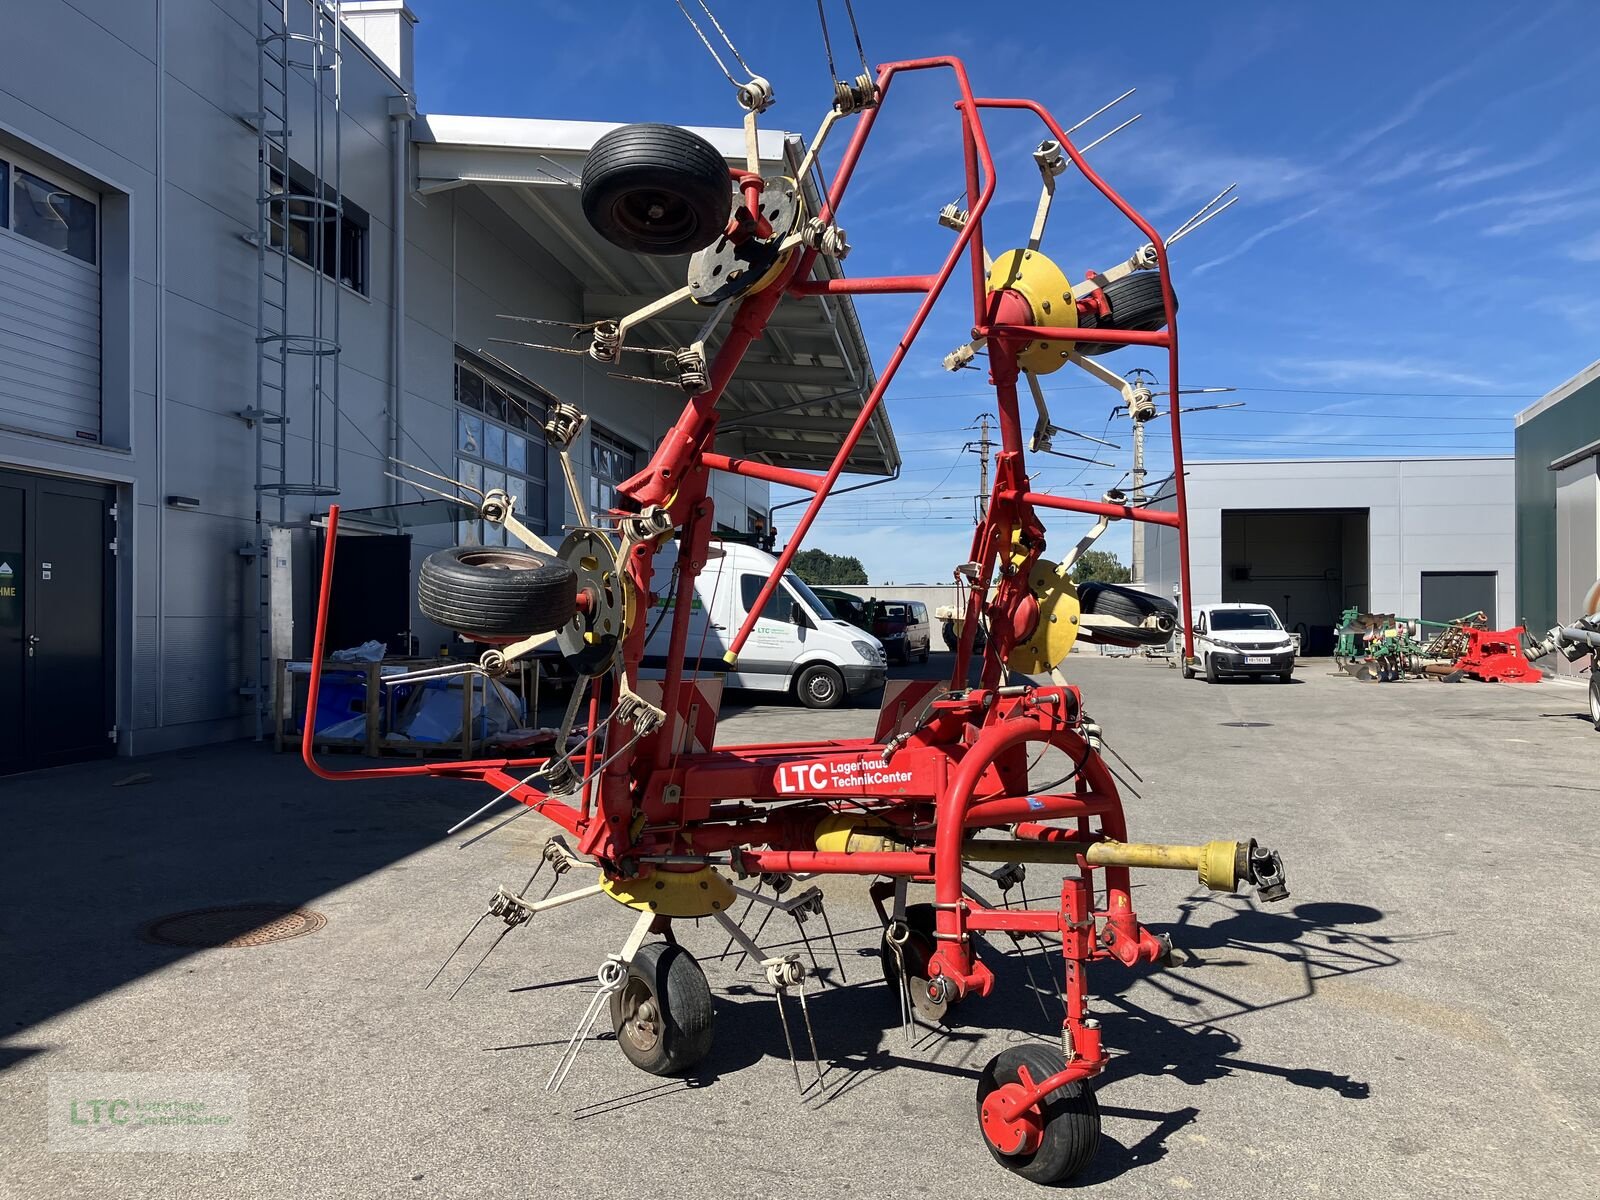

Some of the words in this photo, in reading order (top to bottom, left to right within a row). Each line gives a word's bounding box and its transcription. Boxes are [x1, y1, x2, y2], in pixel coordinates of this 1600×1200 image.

[830, 759, 889, 774] Lagerhaus
[779, 763, 828, 793] LTC
[831, 772, 913, 788] TechnikCenter
